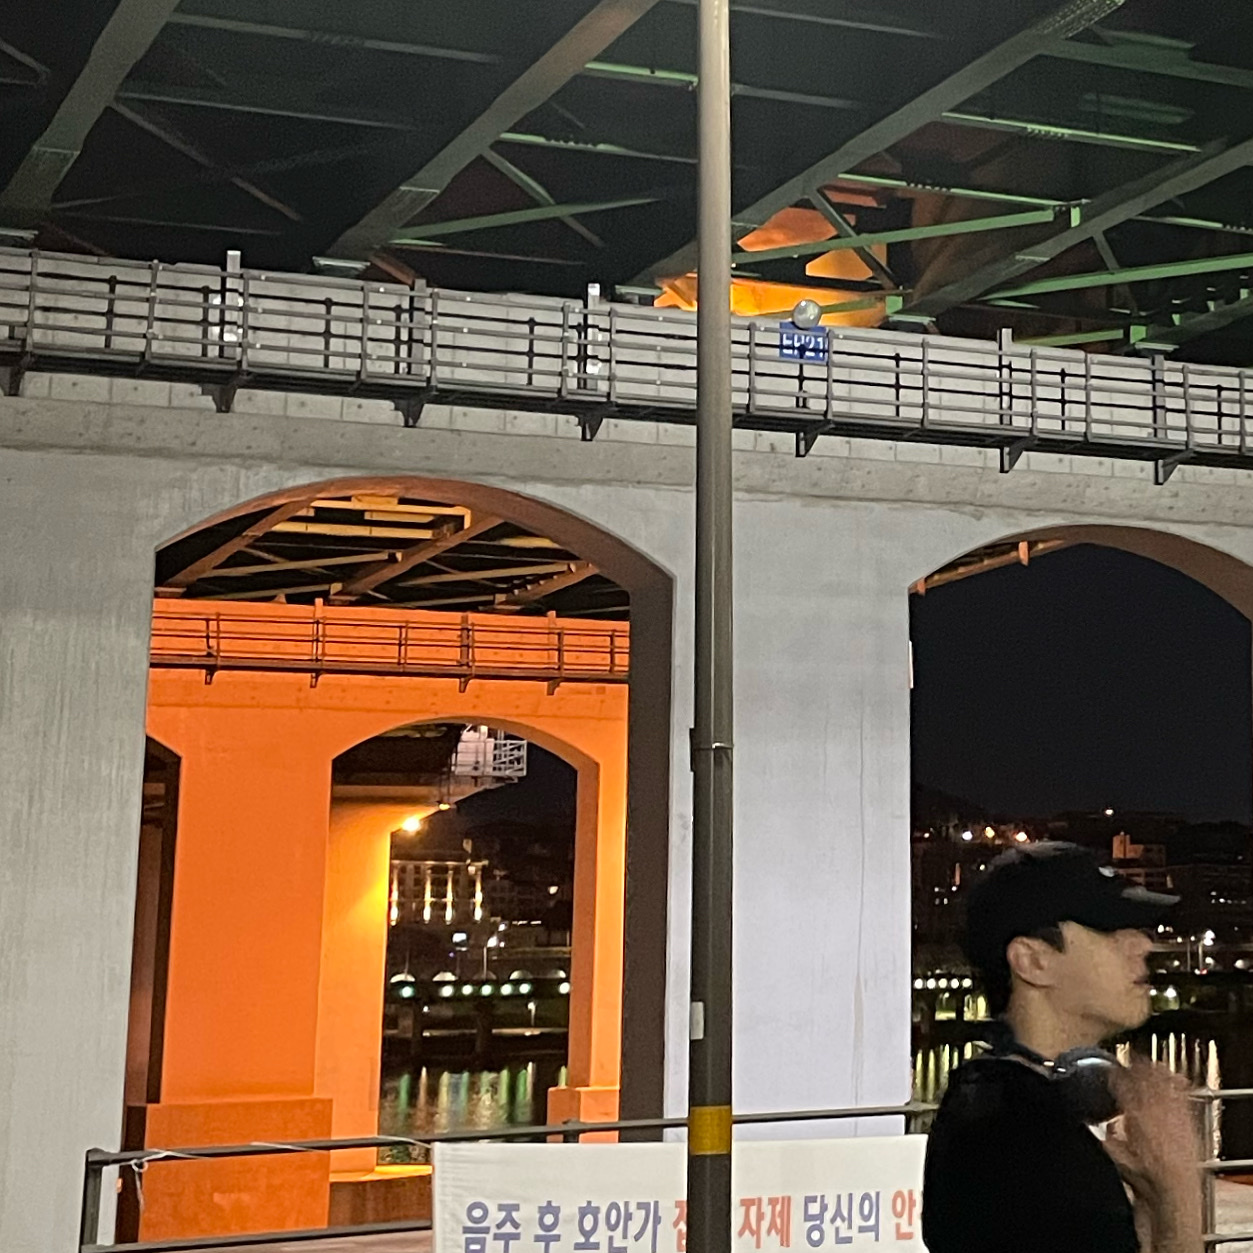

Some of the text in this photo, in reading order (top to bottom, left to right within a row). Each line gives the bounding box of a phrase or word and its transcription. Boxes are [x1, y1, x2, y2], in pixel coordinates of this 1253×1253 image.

[737, 1195, 792, 1250] 자제
[803, 1190, 881, 1248] 당신의
[891, 1188, 922, 1241] 안
